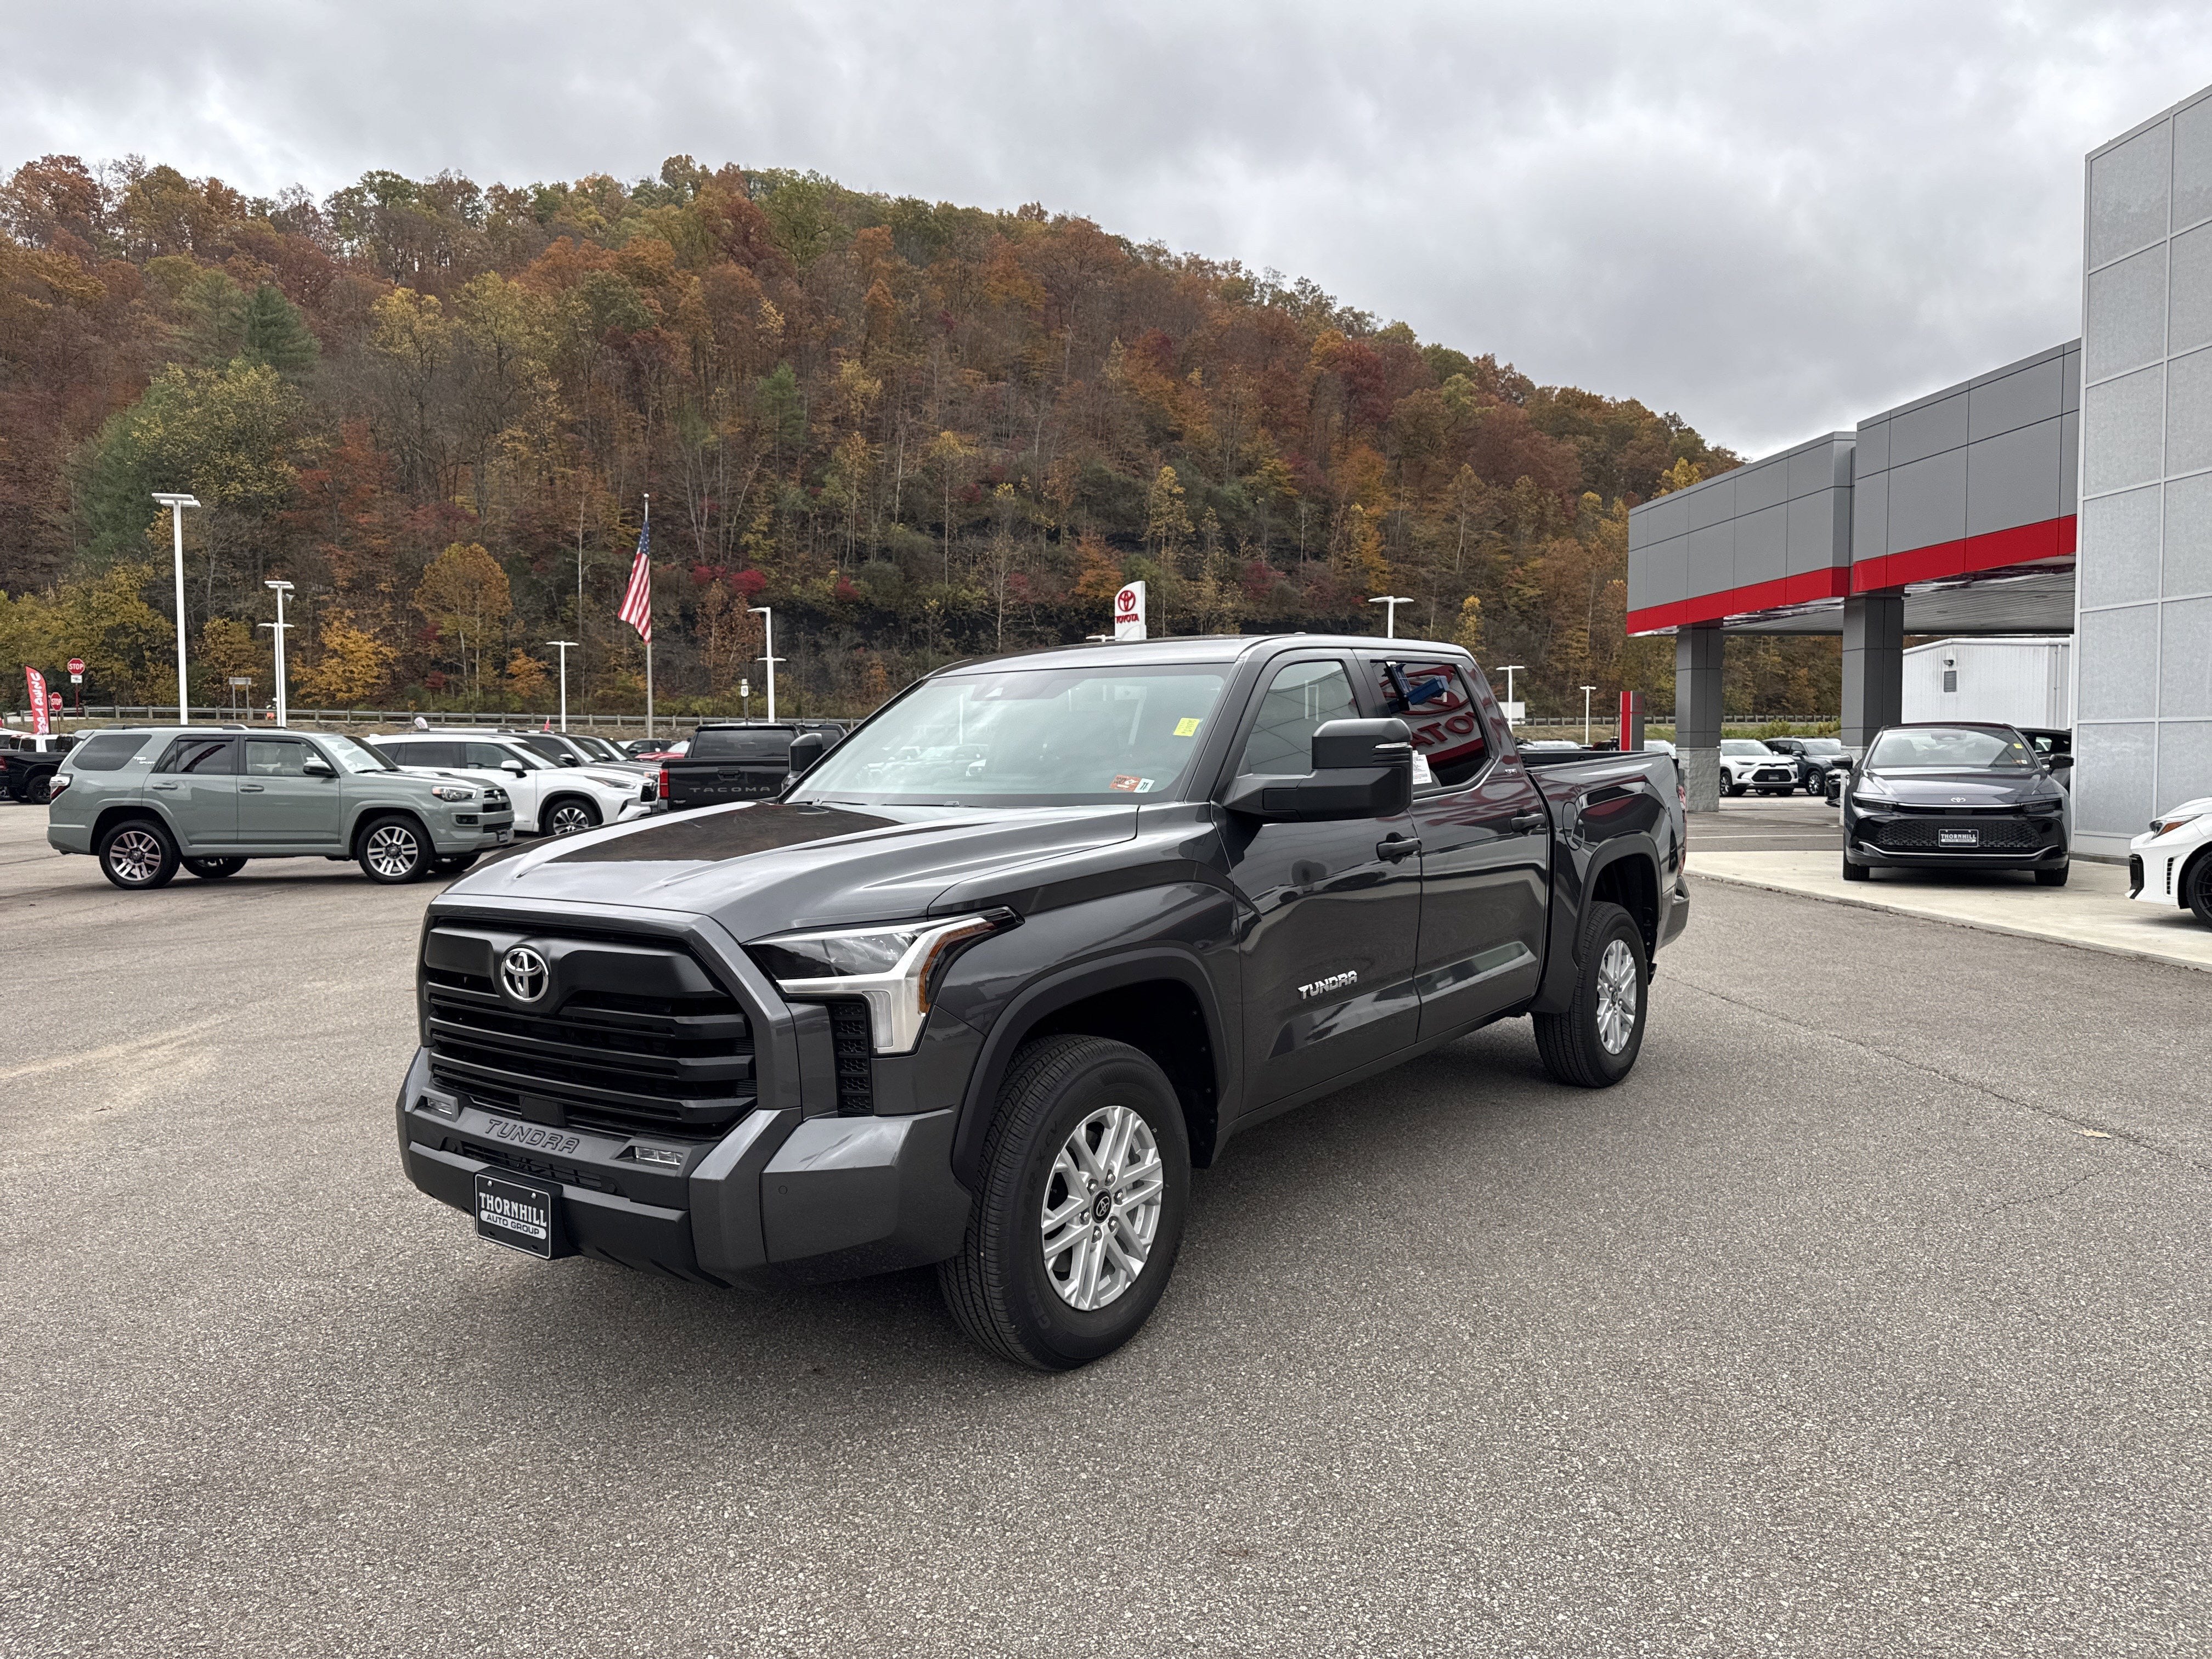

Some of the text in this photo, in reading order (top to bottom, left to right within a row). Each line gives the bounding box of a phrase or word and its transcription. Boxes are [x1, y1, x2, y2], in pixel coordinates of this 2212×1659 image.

[1115, 613, 1139, 624] TOYOTA
[1297, 970, 1357, 1000] TUNDRA
[485, 1119, 580, 1154] TUNDRA
[479, 1192, 547, 1227] THORNHILL
[487, 1214, 539, 1235] AUTO GROUP
